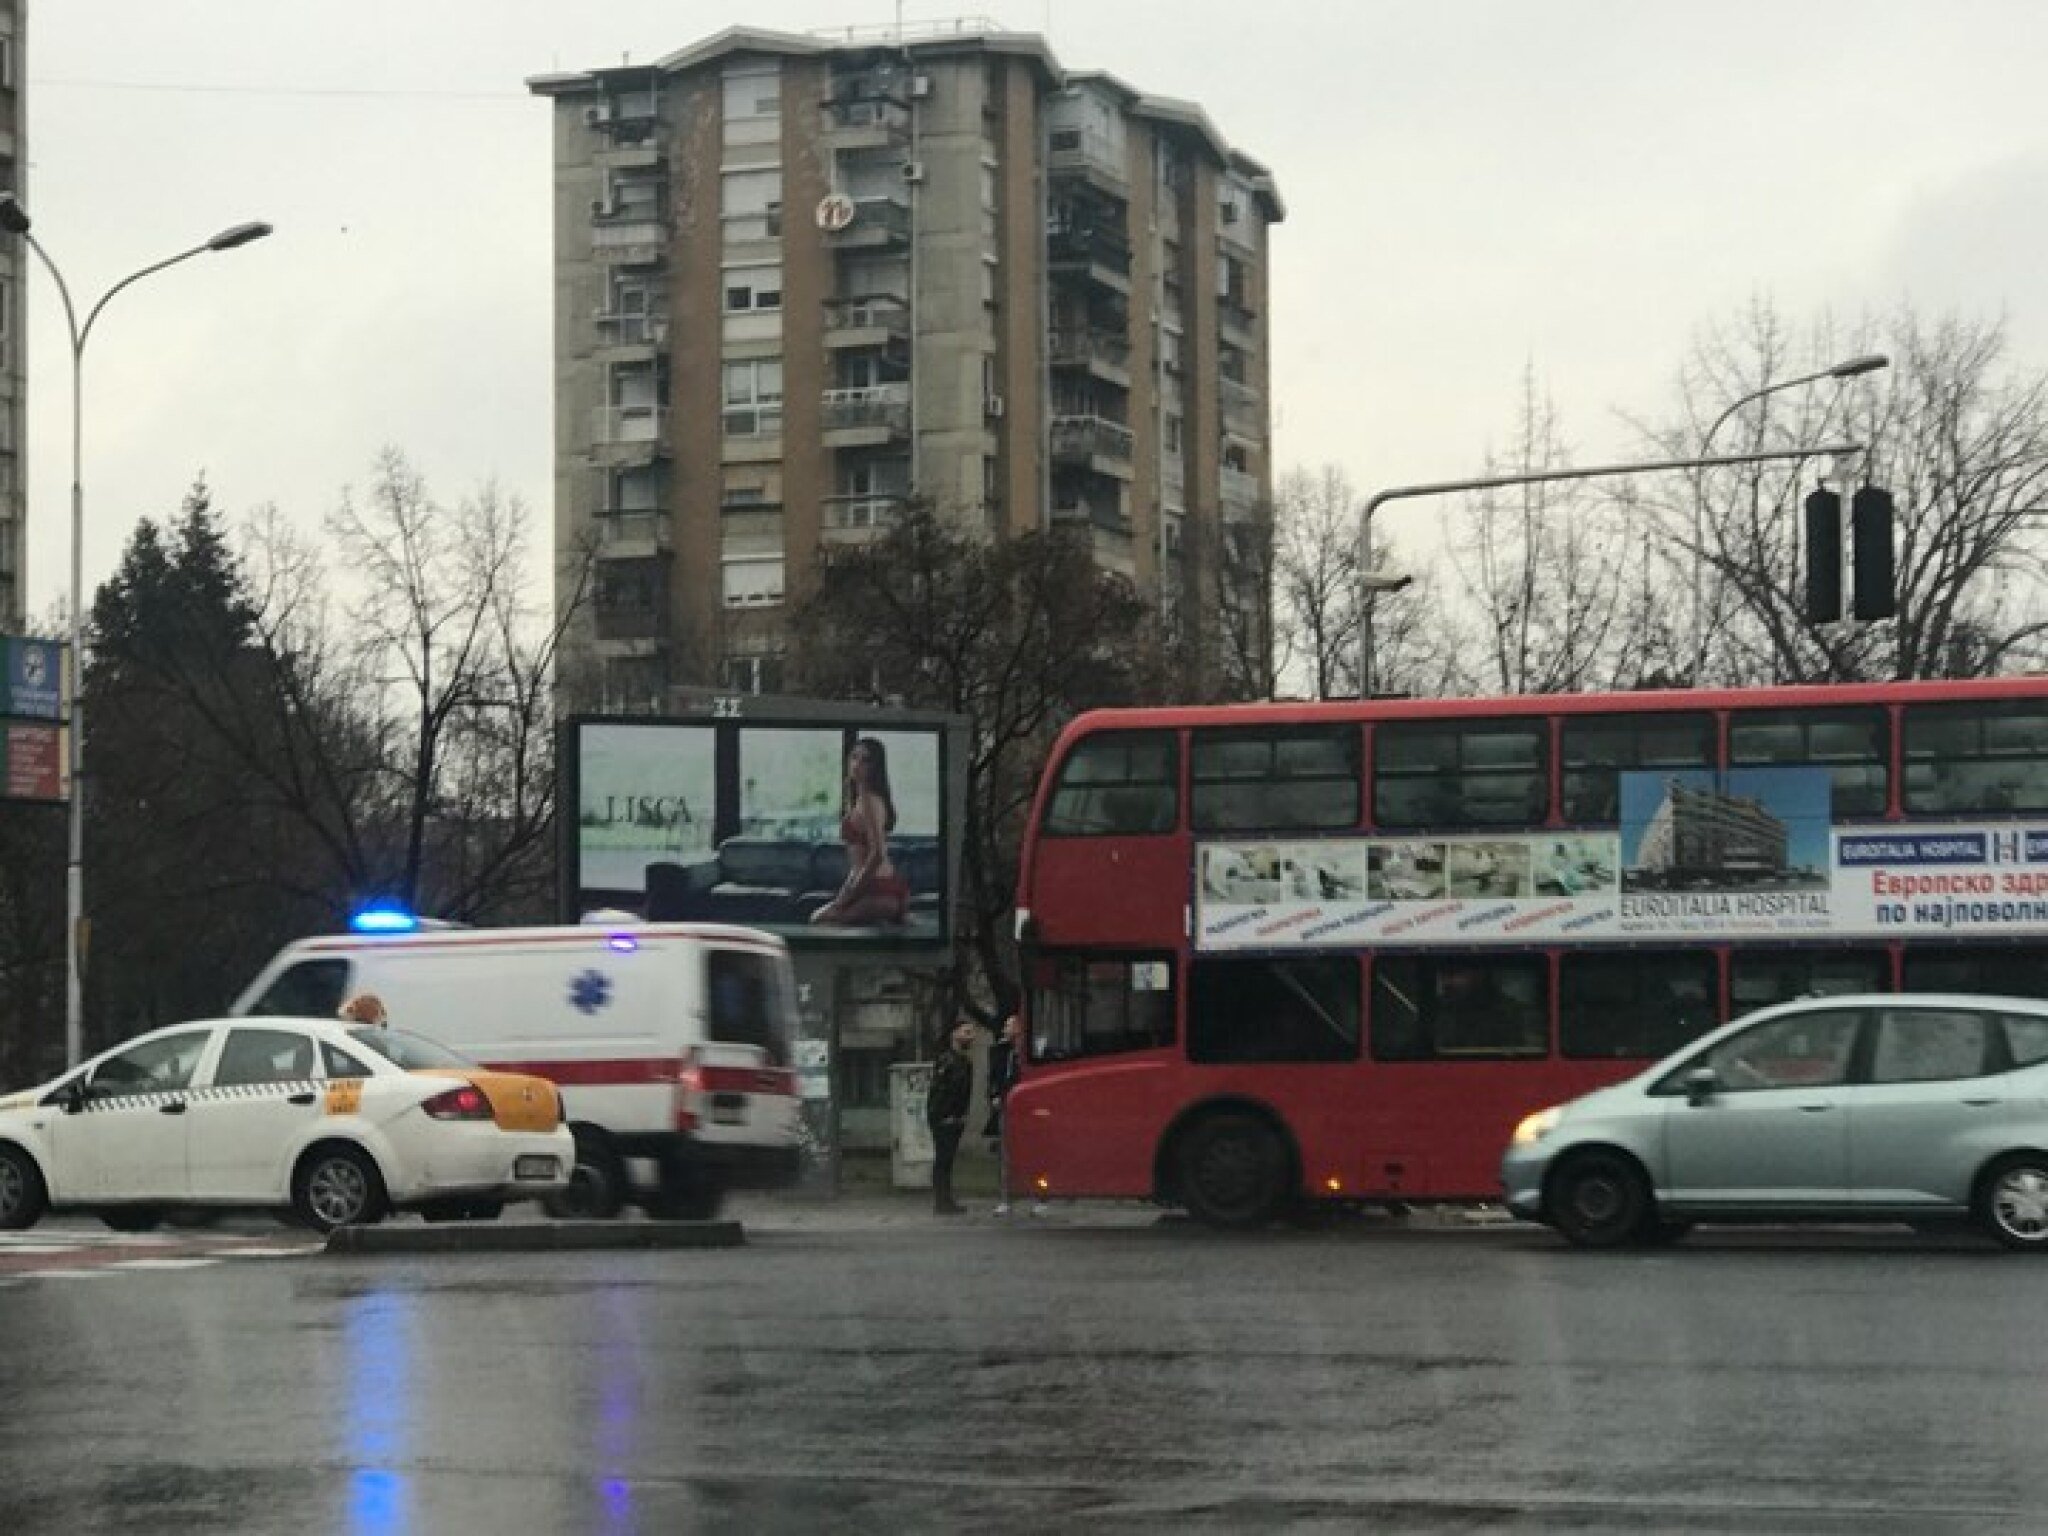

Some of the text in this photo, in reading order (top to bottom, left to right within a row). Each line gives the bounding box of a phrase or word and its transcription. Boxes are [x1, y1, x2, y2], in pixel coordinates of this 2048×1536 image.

[1873, 869, 1995, 901] Европско
[1620, 893, 1830, 917] EUROITALIA HOSPITAL
[1876, 903, 1907, 924] по
